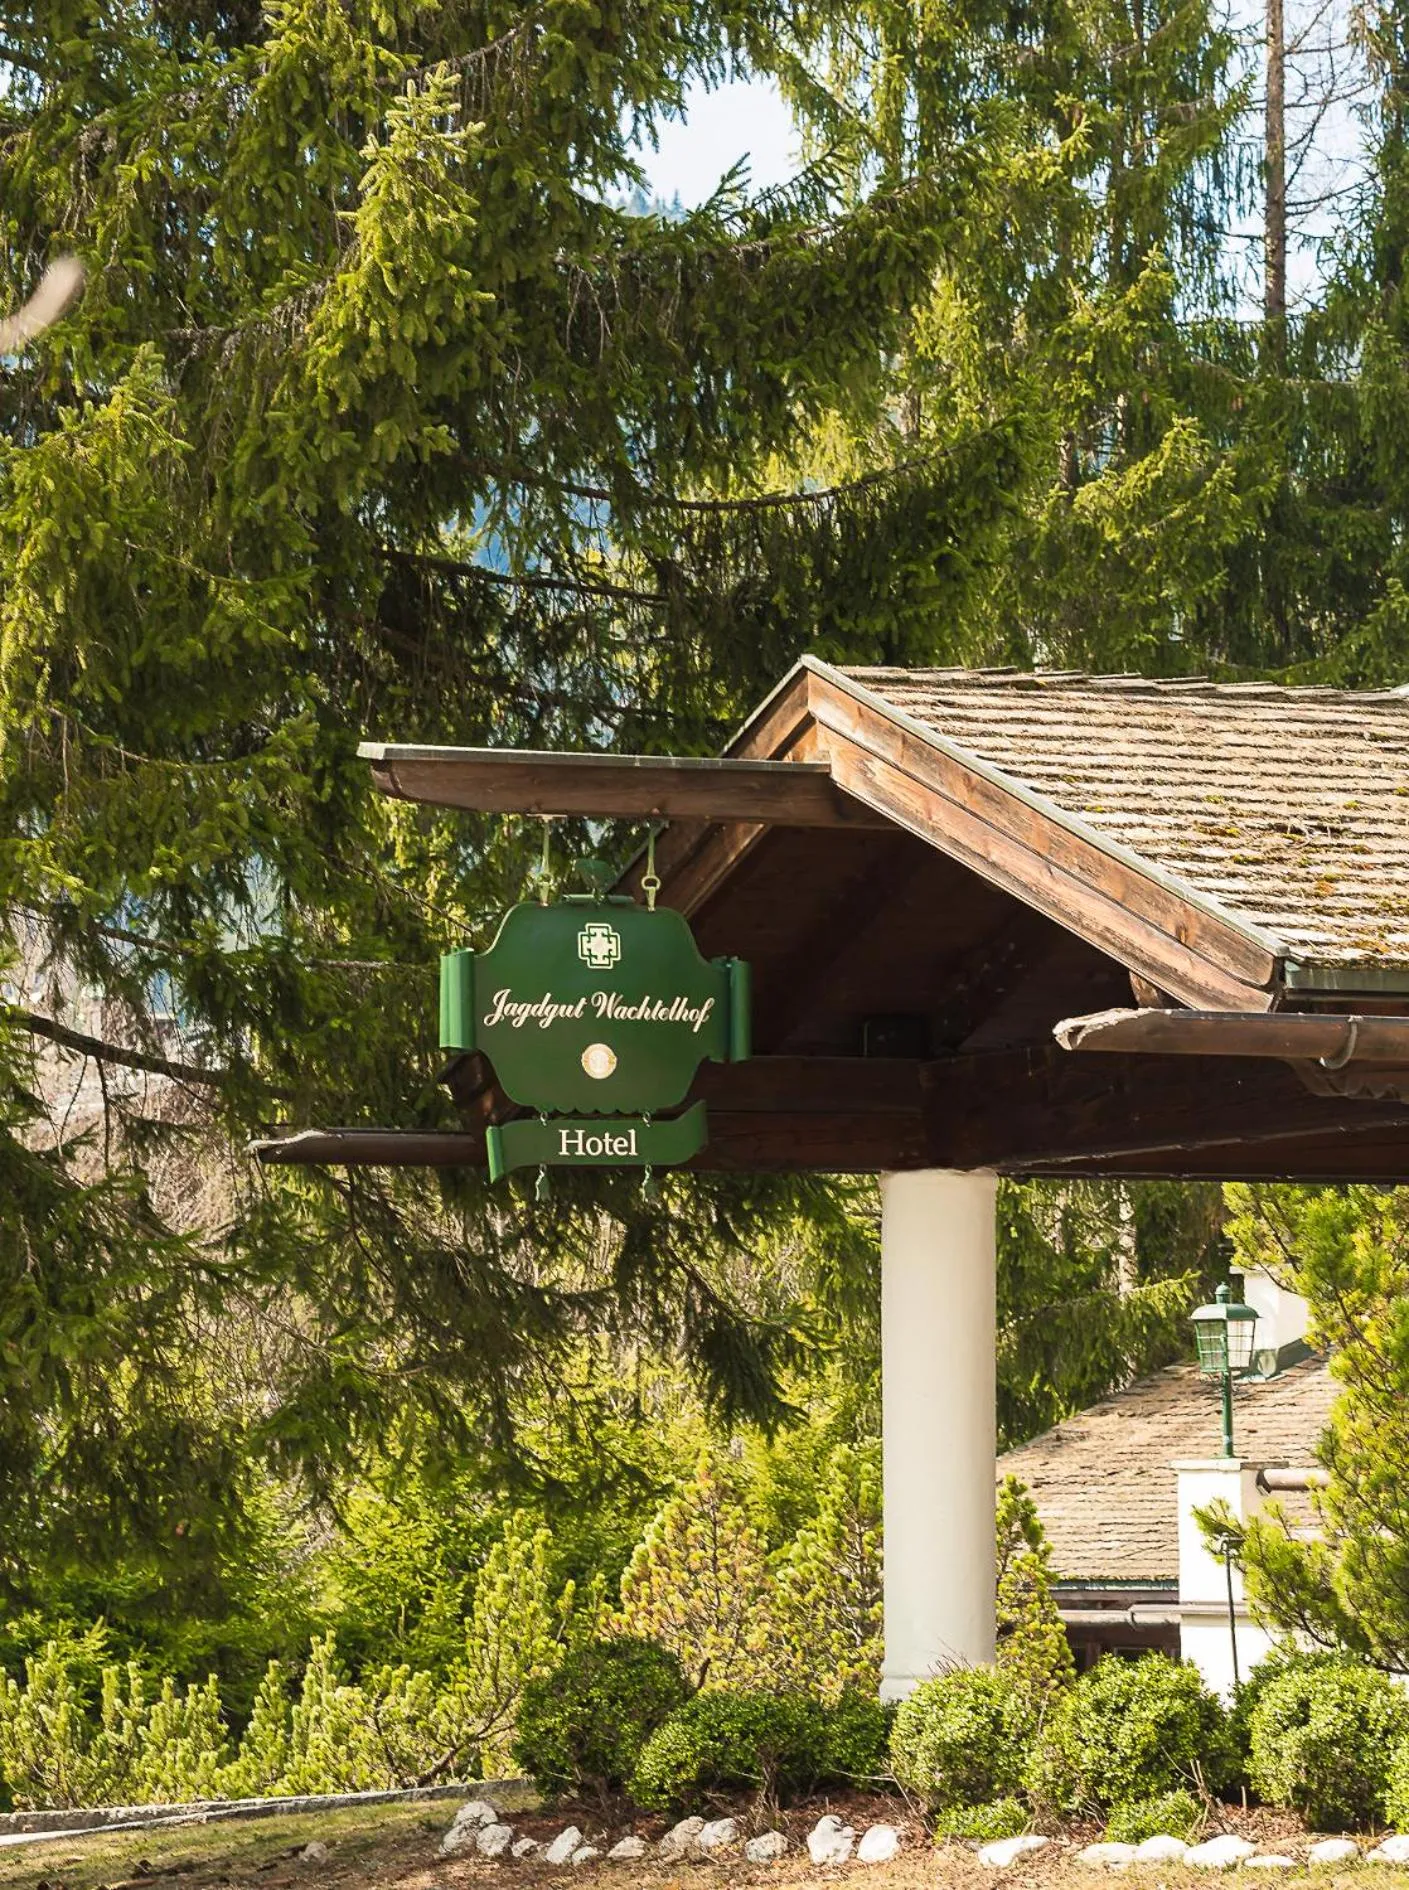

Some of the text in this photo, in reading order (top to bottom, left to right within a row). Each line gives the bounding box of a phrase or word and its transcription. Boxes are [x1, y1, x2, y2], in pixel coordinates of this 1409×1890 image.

[483, 988, 715, 1033] Jagdgut Wachtelhof
[558, 1129, 638, 1156] Hotel
